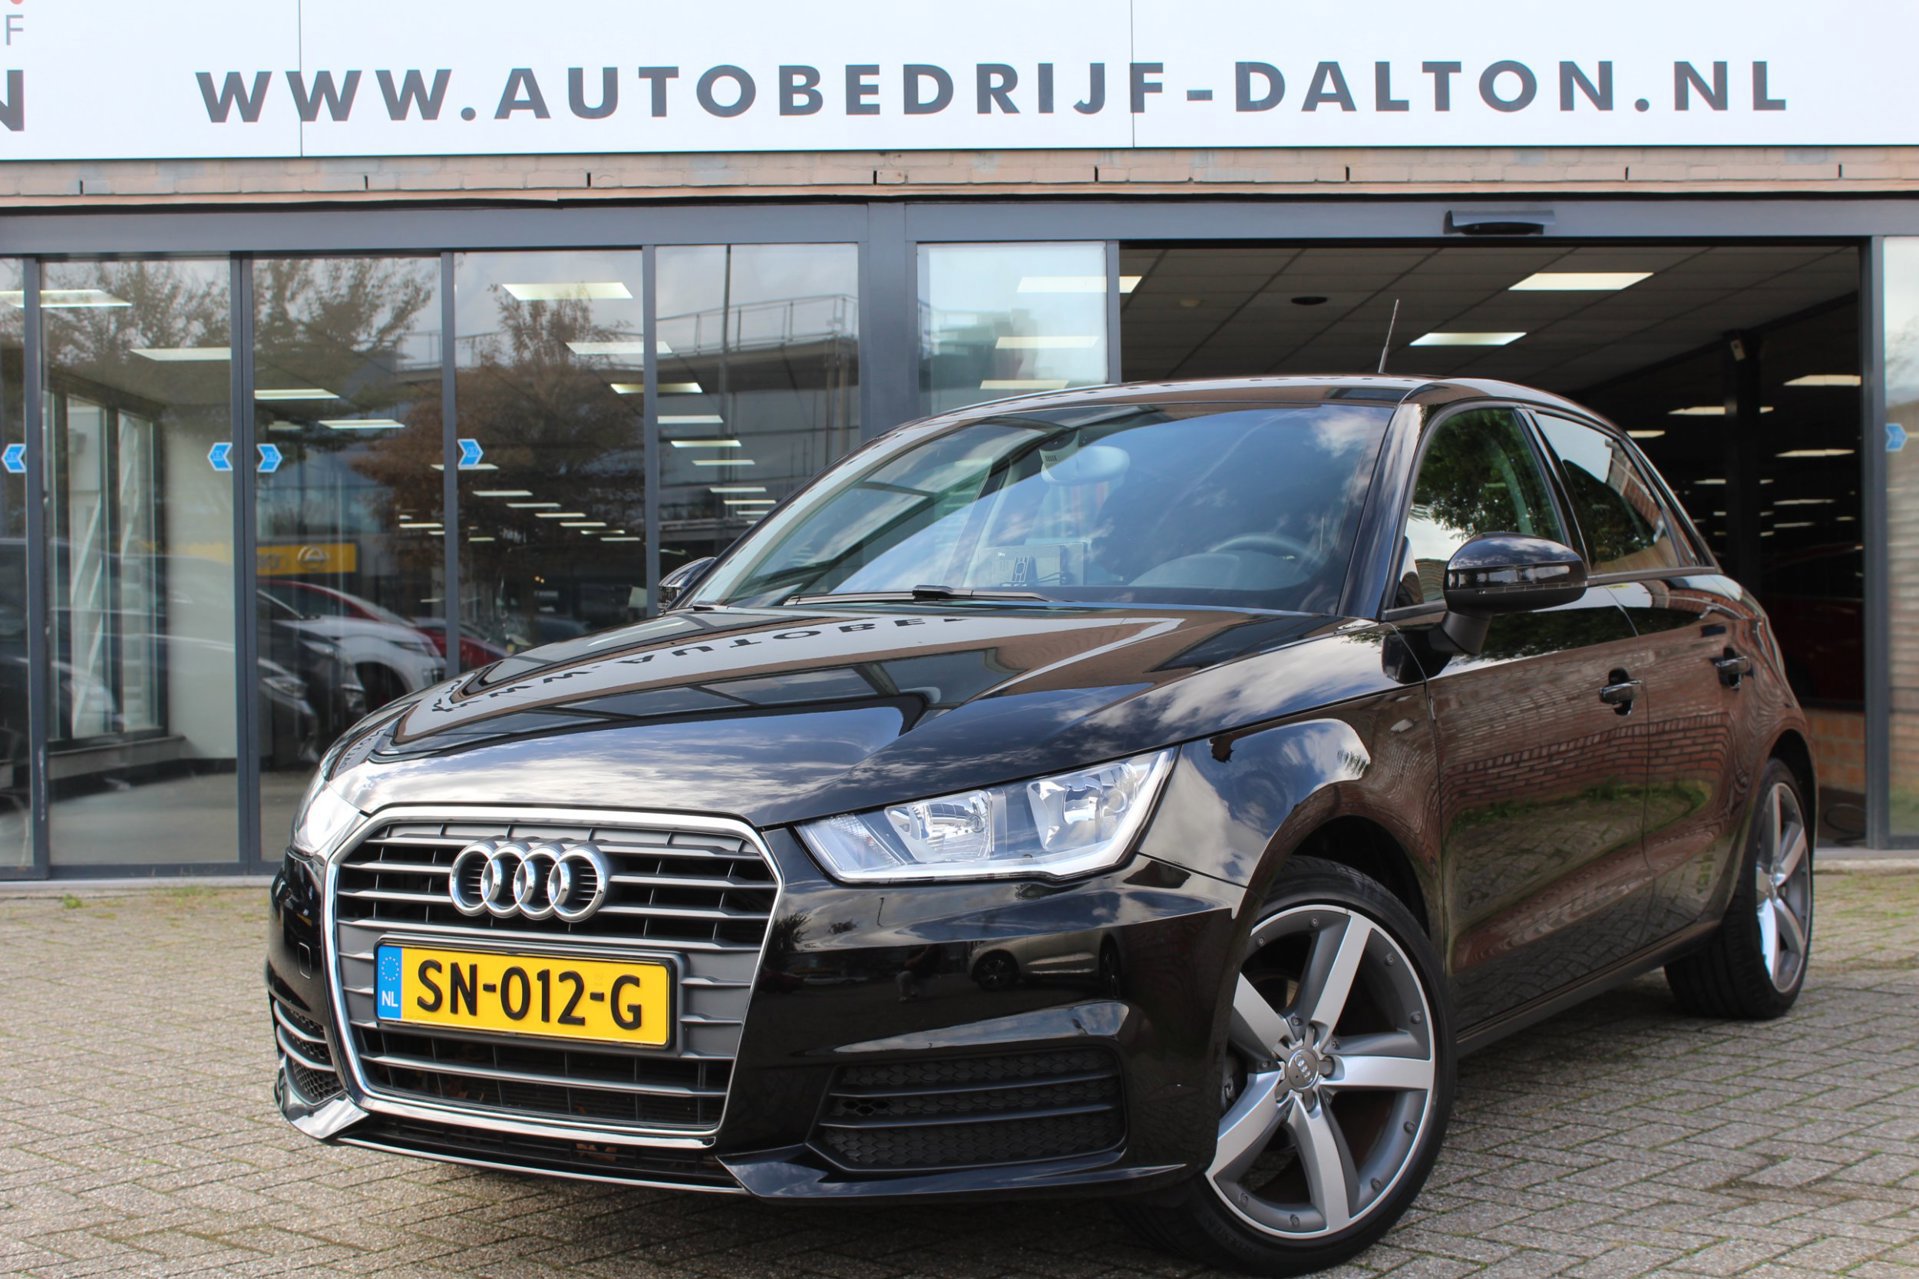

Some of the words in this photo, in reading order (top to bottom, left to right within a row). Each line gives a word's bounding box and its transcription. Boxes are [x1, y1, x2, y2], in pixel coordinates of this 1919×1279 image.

[195, 61, 1786, 122] WWW.AUTOBEDRIJF-DALTON.NL
[381, 990, 399, 1008] NL
[416, 959, 643, 1031] SN-012-G
